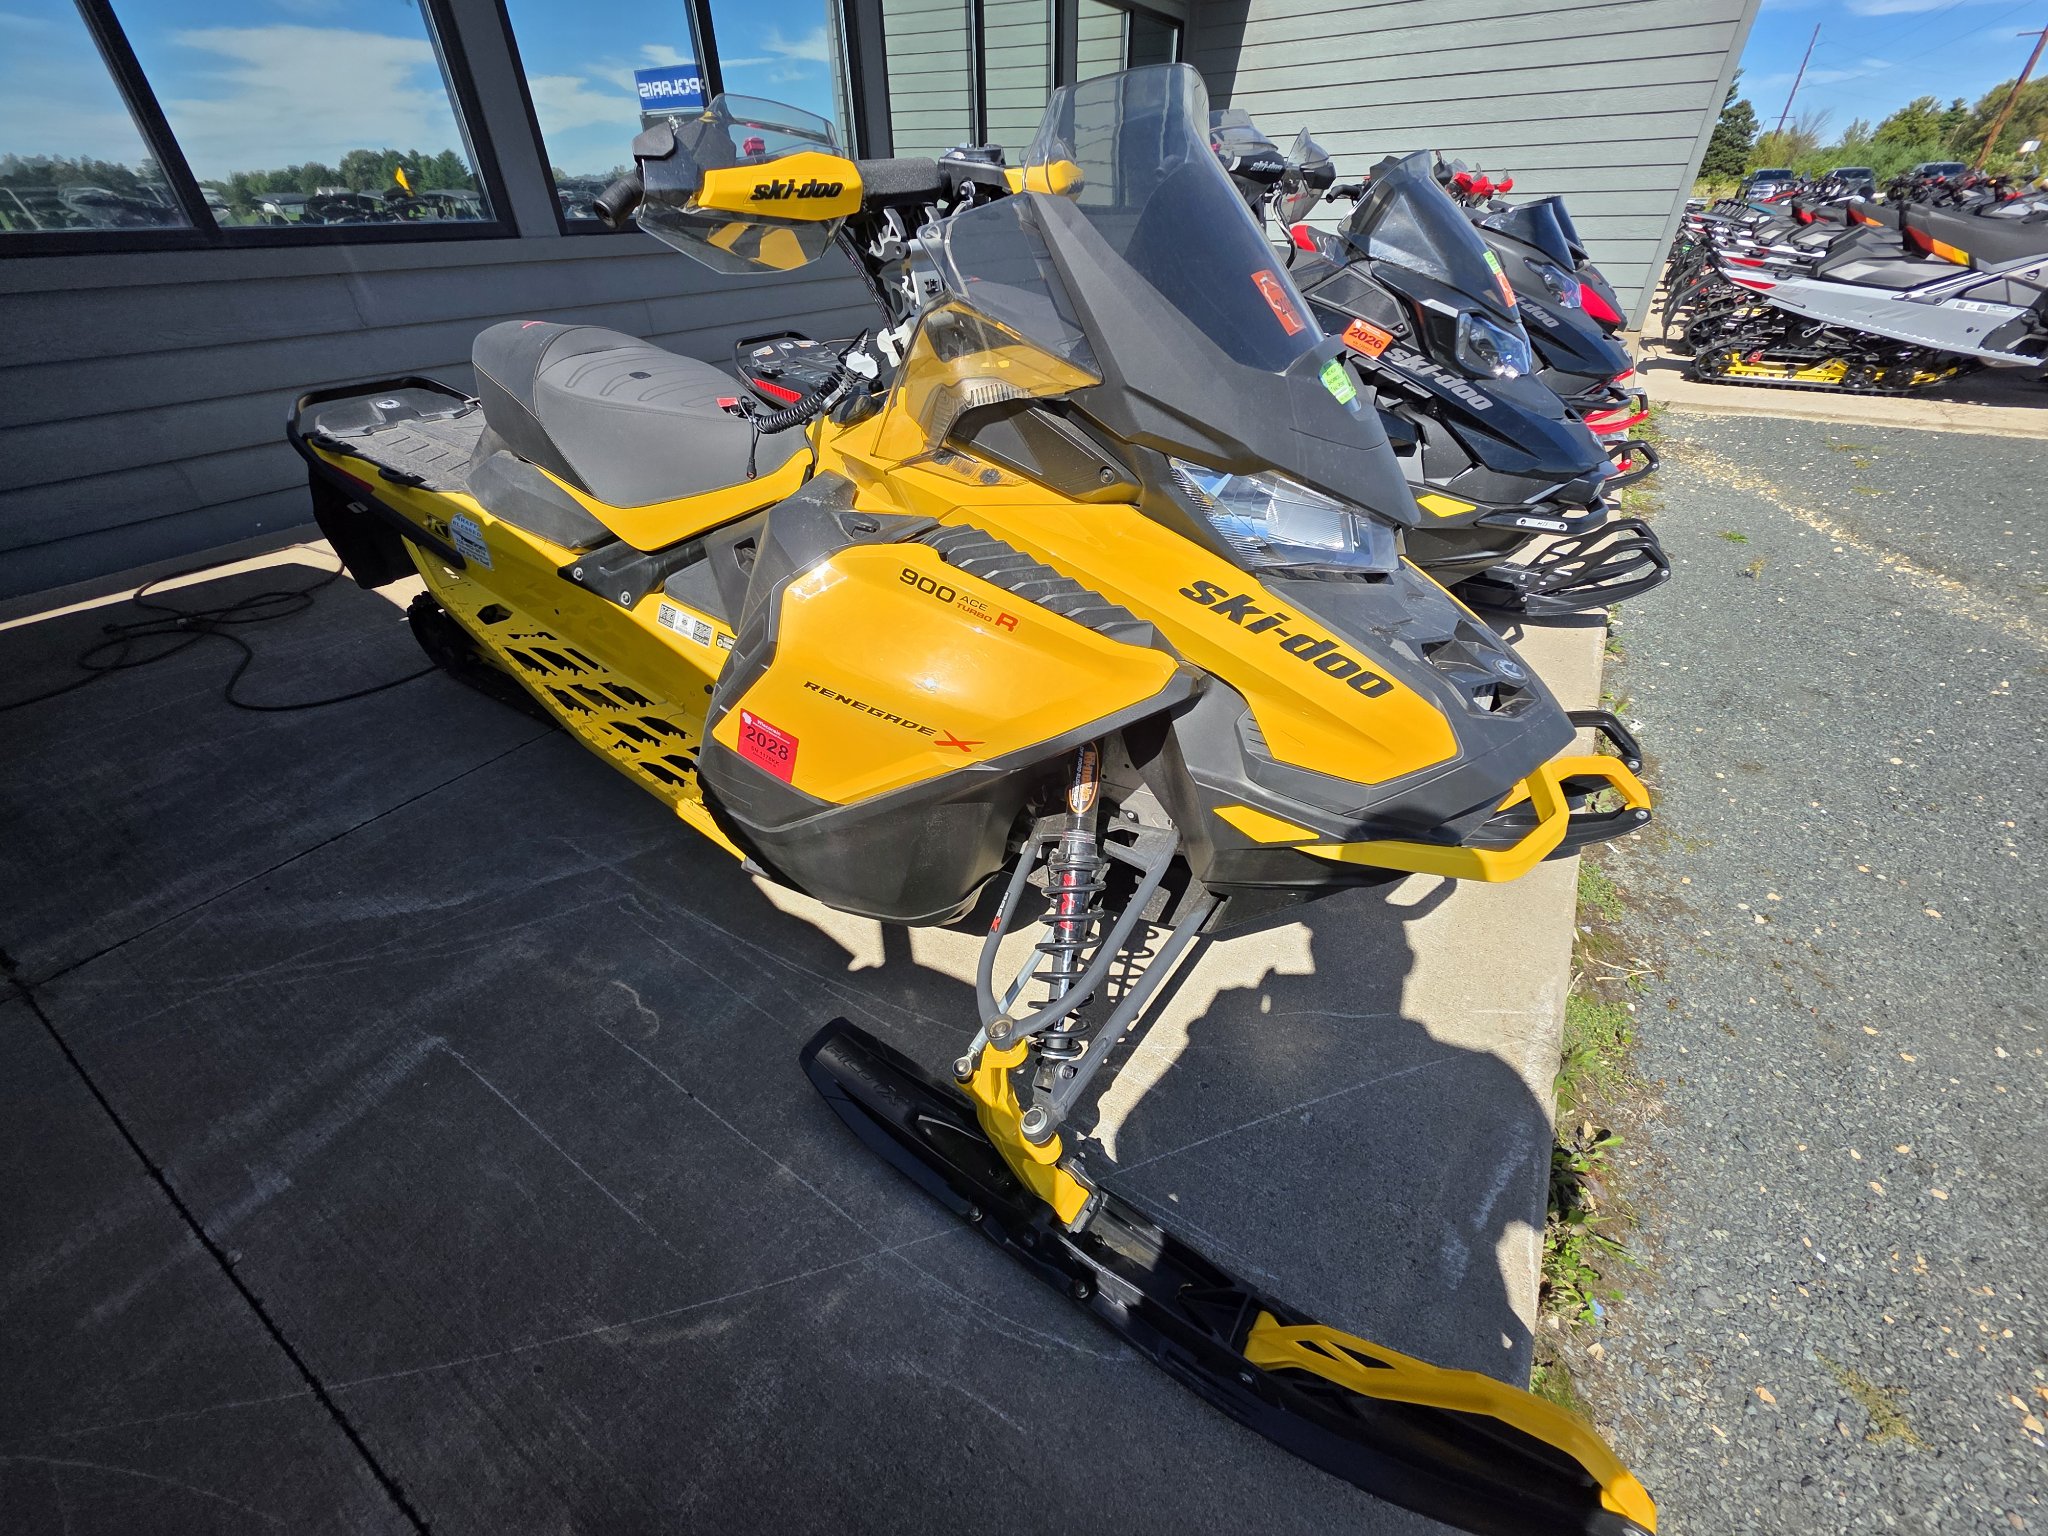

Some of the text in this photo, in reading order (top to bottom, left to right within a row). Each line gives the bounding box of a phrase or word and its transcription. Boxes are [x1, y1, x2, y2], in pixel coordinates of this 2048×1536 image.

[750, 178, 844, 200] ski-doo
[1349, 327, 1384, 349] 2026
[1384, 347, 1494, 411] ski-doo
[899, 567, 989, 612] 900 ACE
[956, 602, 1019, 633] TURBO R
[1178, 580, 1395, 699] ski-doo
[803, 681, 937, 737] RENEGADE
[933, 729, 987, 753] X
[745, 725, 789, 761] 2028
